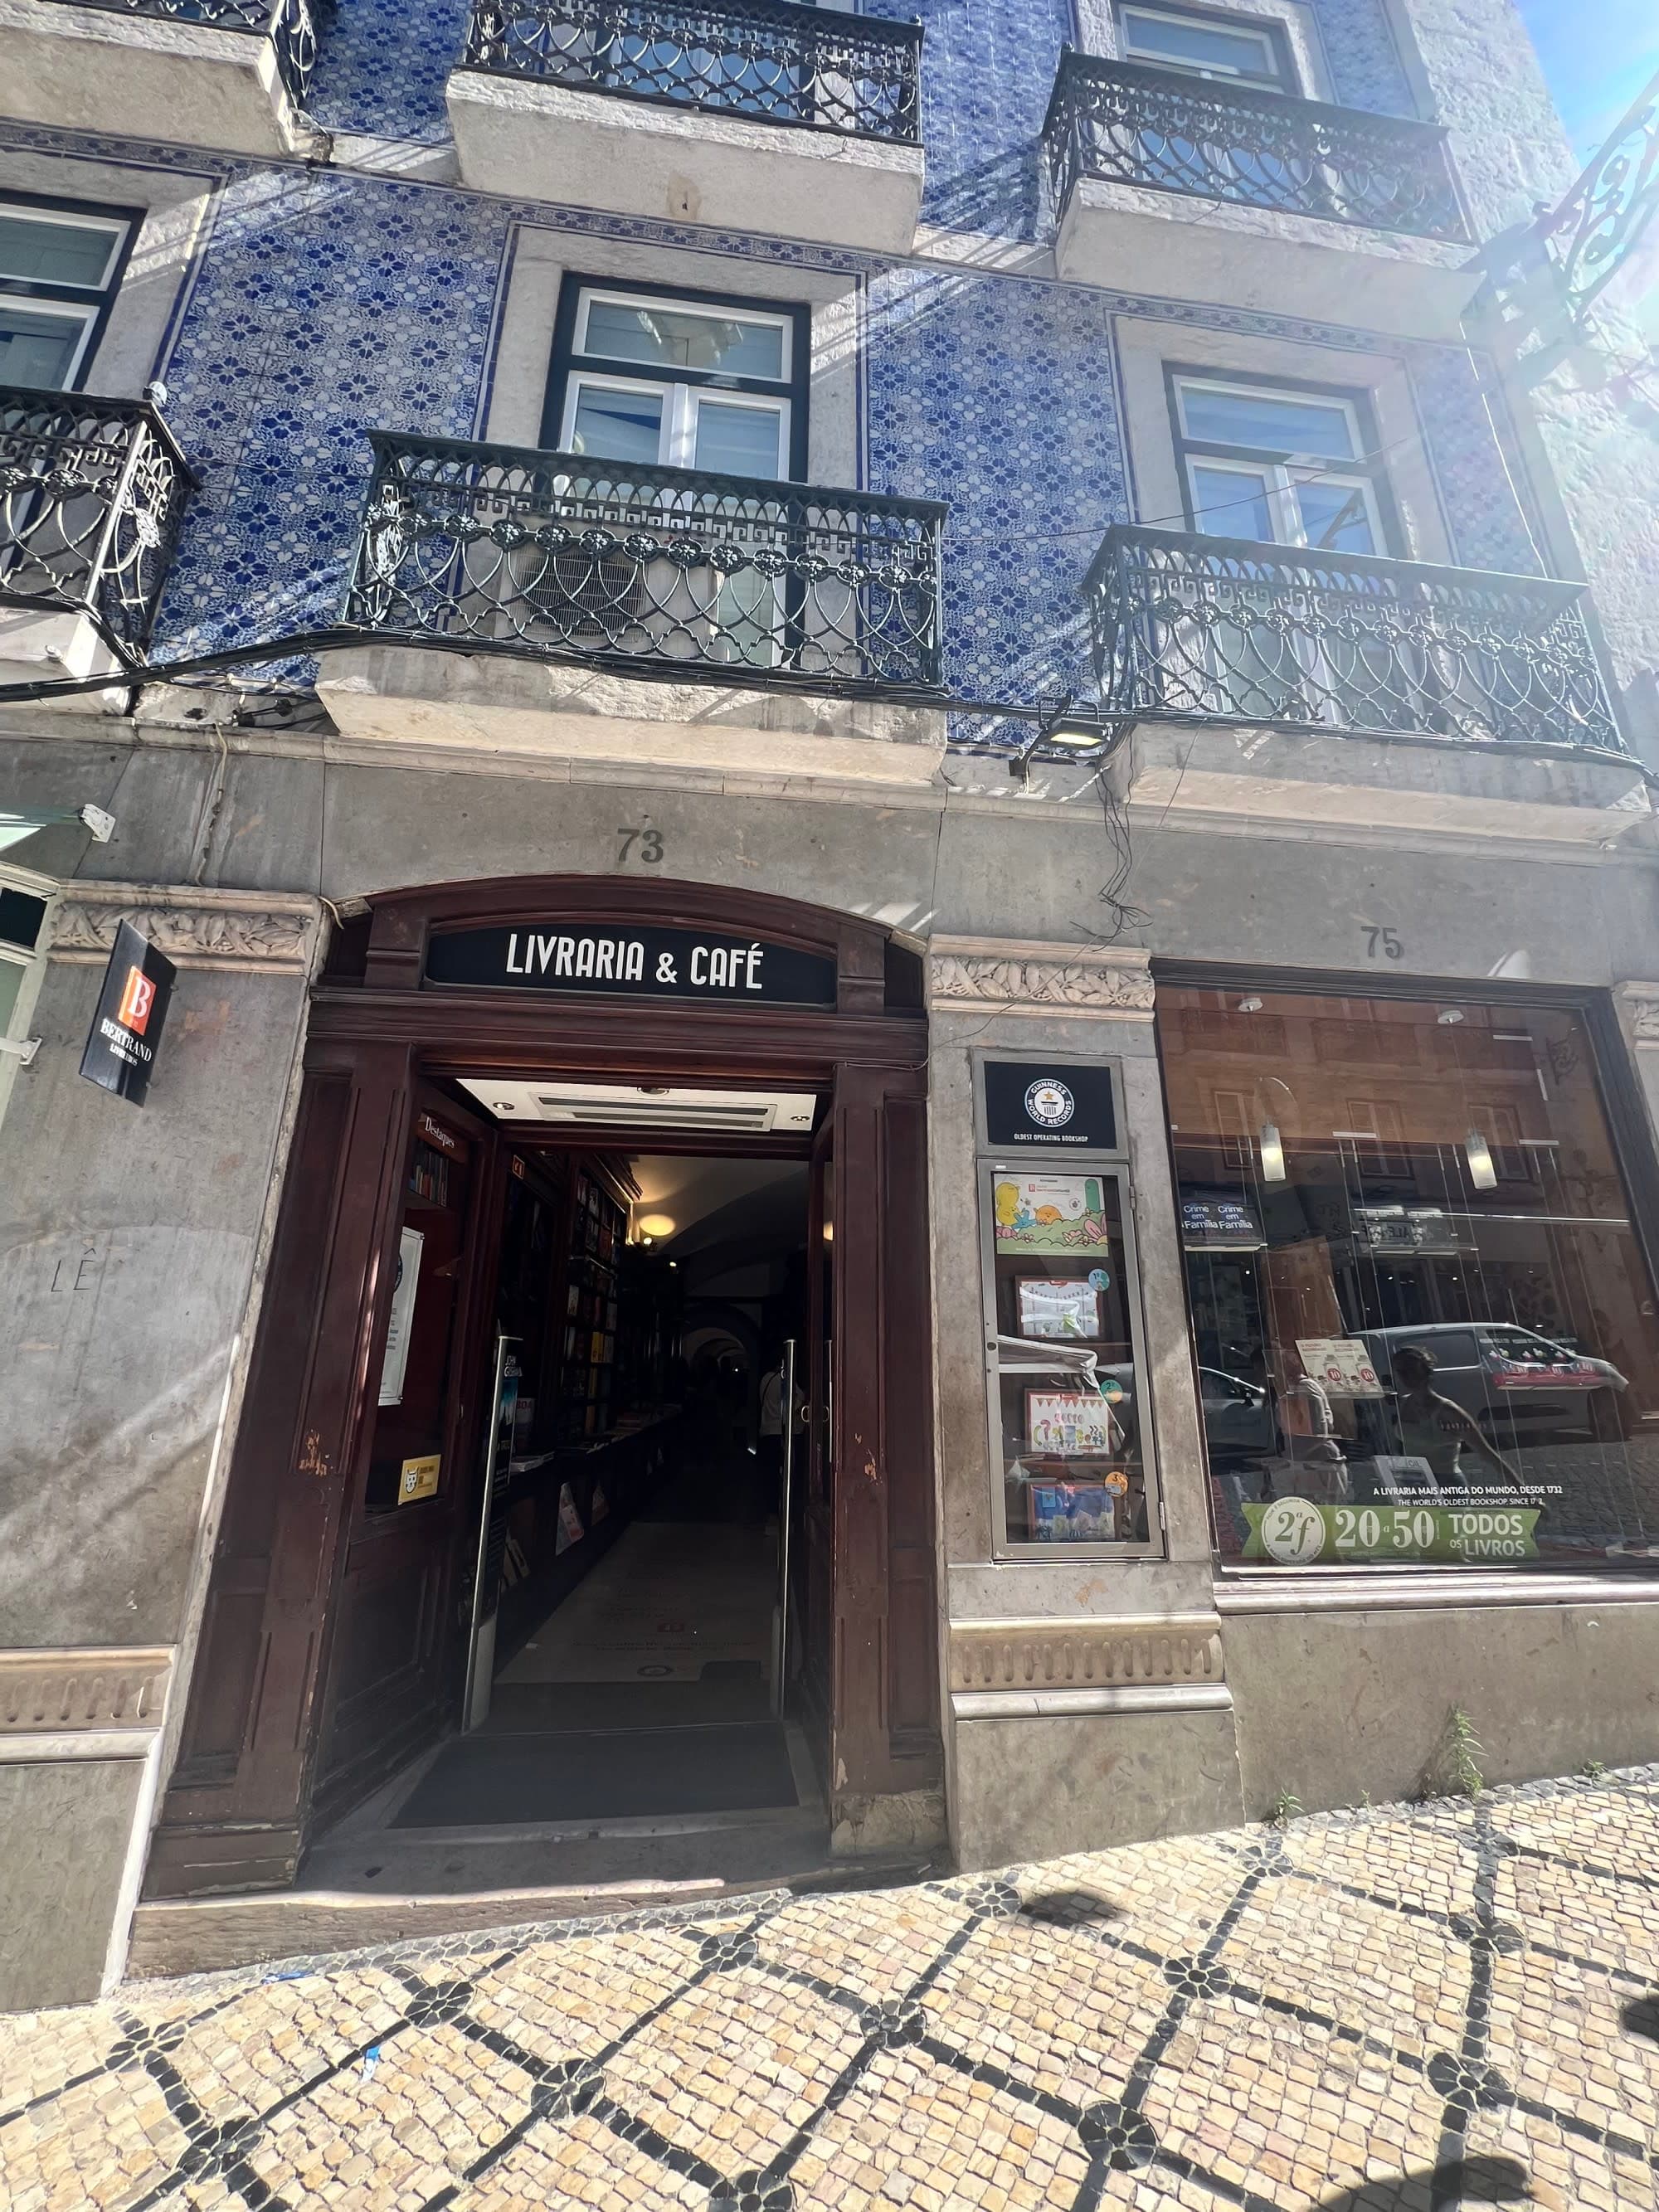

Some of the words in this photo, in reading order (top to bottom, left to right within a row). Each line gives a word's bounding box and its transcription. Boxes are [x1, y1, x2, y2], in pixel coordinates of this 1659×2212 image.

[617, 828, 664, 863] 73
[1360, 926, 1404, 960] 75
[506, 933, 645, 981] LIVRARIA
[655, 952, 677, 984] &
[690, 942, 764, 989] CAFÉ
[128, 976, 151, 1018] B
[100, 1018, 153, 1062] BERTRAND
[1030, 1081, 1067, 1095] GUINNESS
[1027, 1099, 1046, 1122] WORLD
[1047, 1100, 1072, 1125] RECORDS
[425, 1116, 455, 1148] Destaques
[1218, 1205, 1244, 1213] Crime
[1330, 1370, 1340, 1380] 10
[1364, 1370, 1374, 1380] 10
[1373, 1487, 1380, 1495] A
[1380, 1487, 1417, 1495] LIVRARIA
[1418, 1486, 1438, 1495] MAIS
[1440, 1486, 1470, 1495] ANTIGA
[1471, 1486, 1484, 1495] DO
[1485, 1485, 1520, 1495] MUNDO,
[1520, 1485, 1546, 1494] DESDE
[1546, 1485, 1563, 1494] 1732
[1530, 1497, 1543, 1505] 172
[1335, 1510, 1380, 1548] 20
[1383, 1525, 1390, 1534] a
[1393, 1510, 1435, 1548] 50
[1448, 1514, 1523, 1536] TODOS
[1449, 1539, 1462, 1548] OS
[1464, 1539, 1525, 1557] LIVROS
